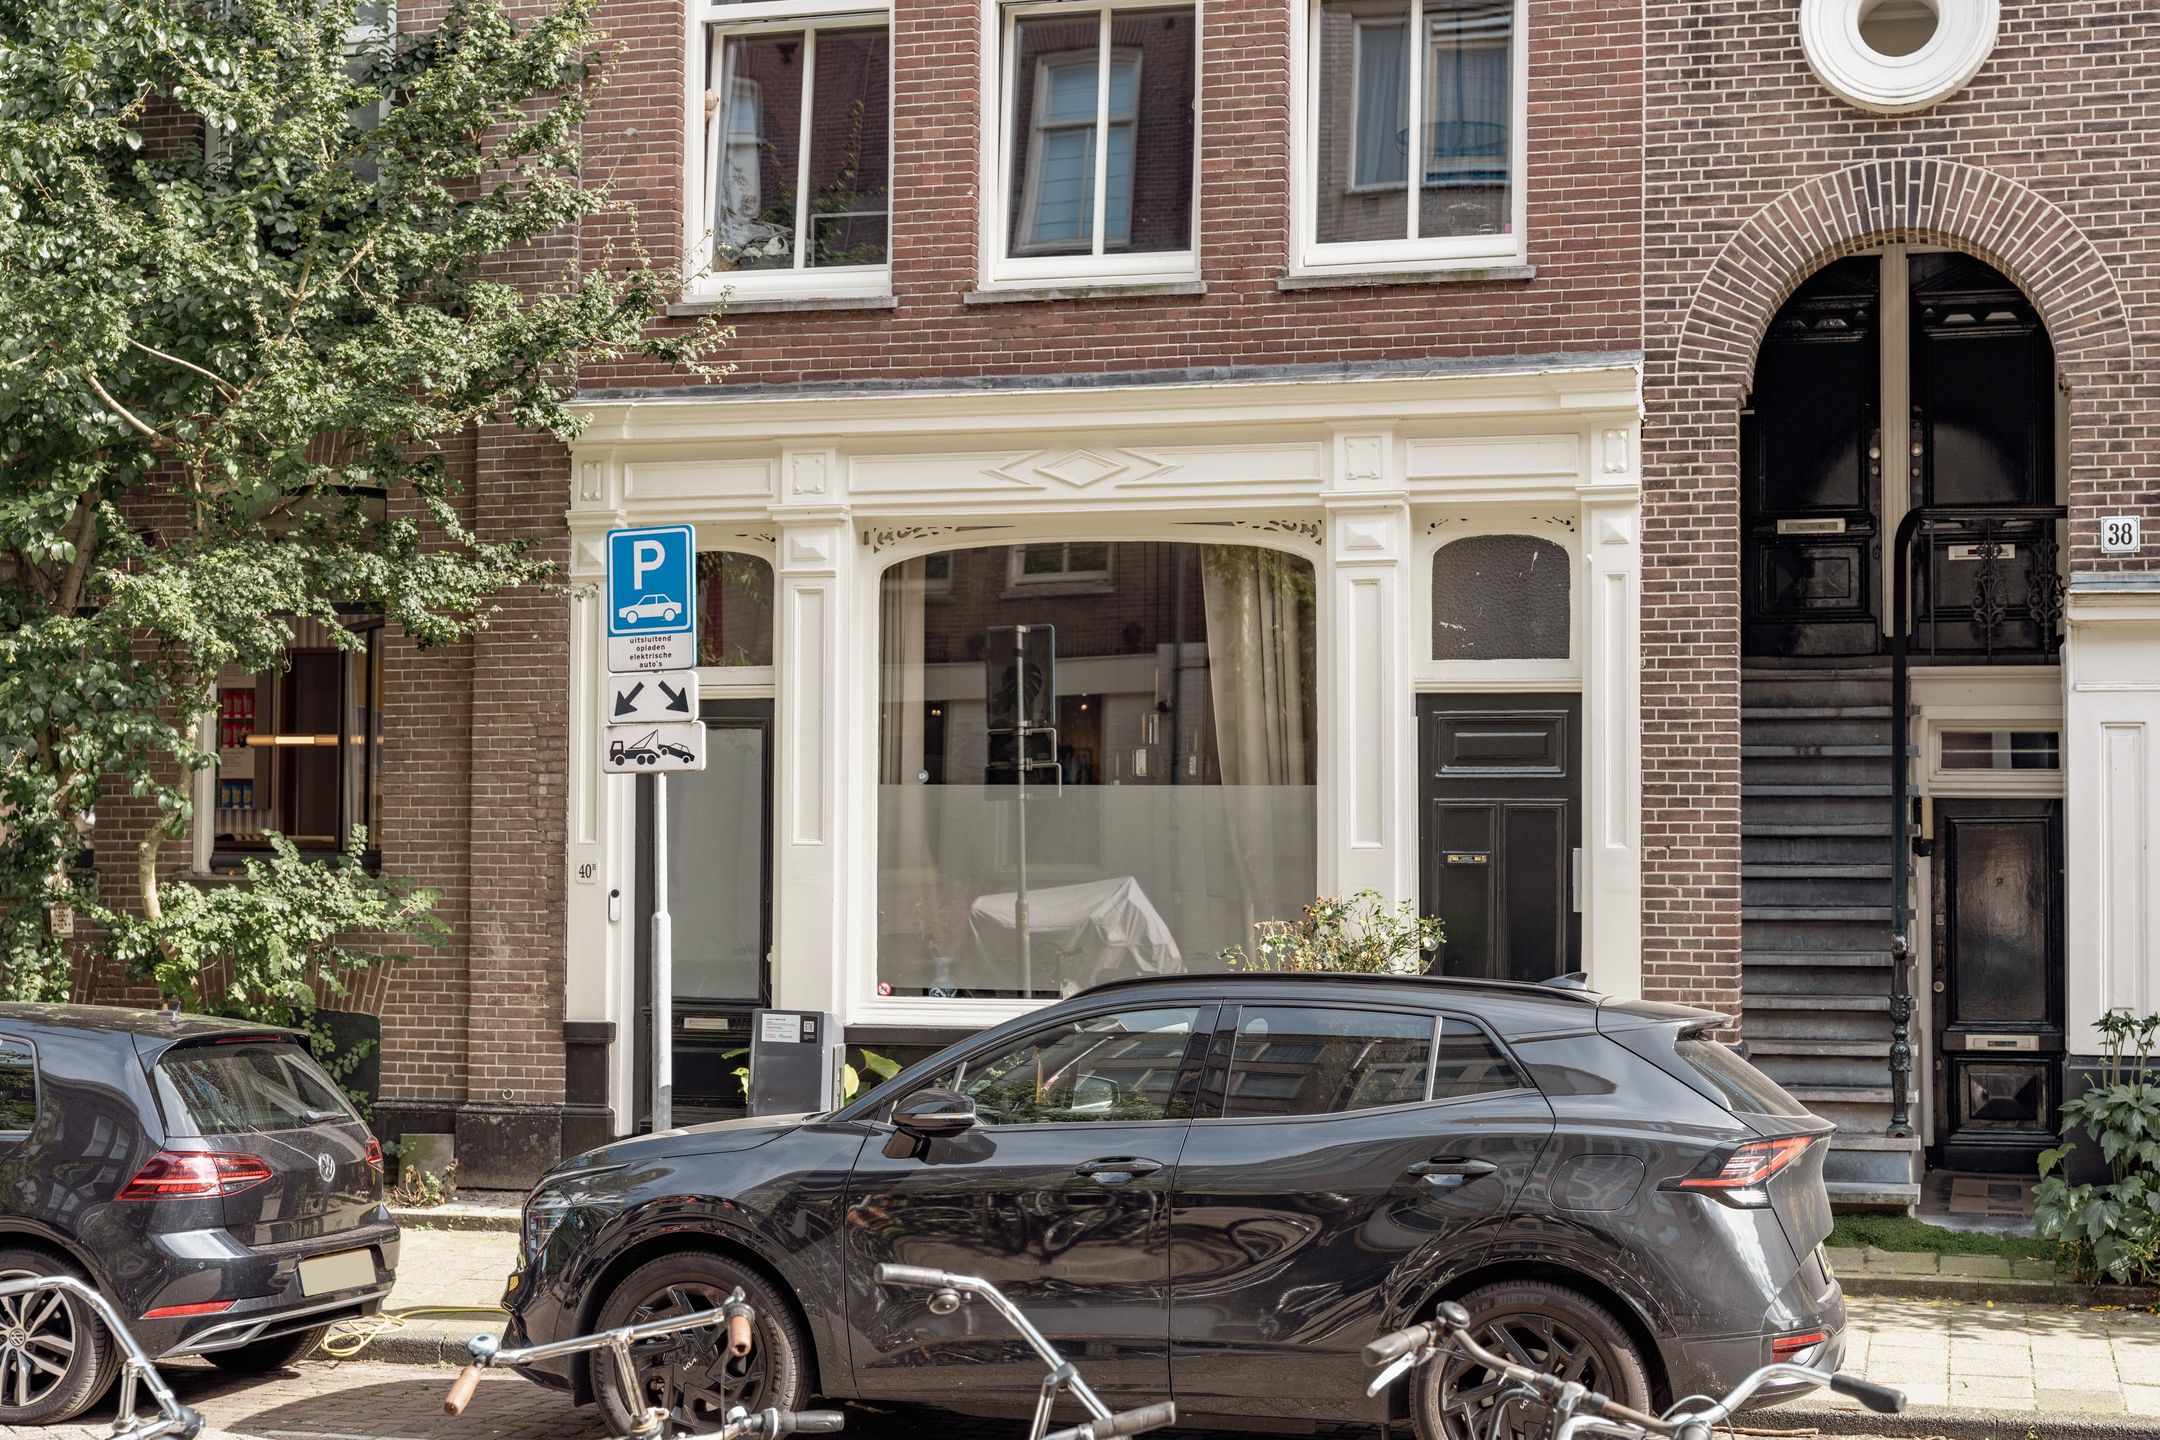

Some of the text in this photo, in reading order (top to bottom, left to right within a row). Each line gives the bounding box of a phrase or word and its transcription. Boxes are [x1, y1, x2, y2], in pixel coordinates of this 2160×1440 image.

[2108, 523, 2132, 545] 38
[634, 540, 666, 590] P
[630, 635, 672, 644] uitsluitend
[636, 644, 666, 652] opladen
[629, 652, 672, 660] elektrische
